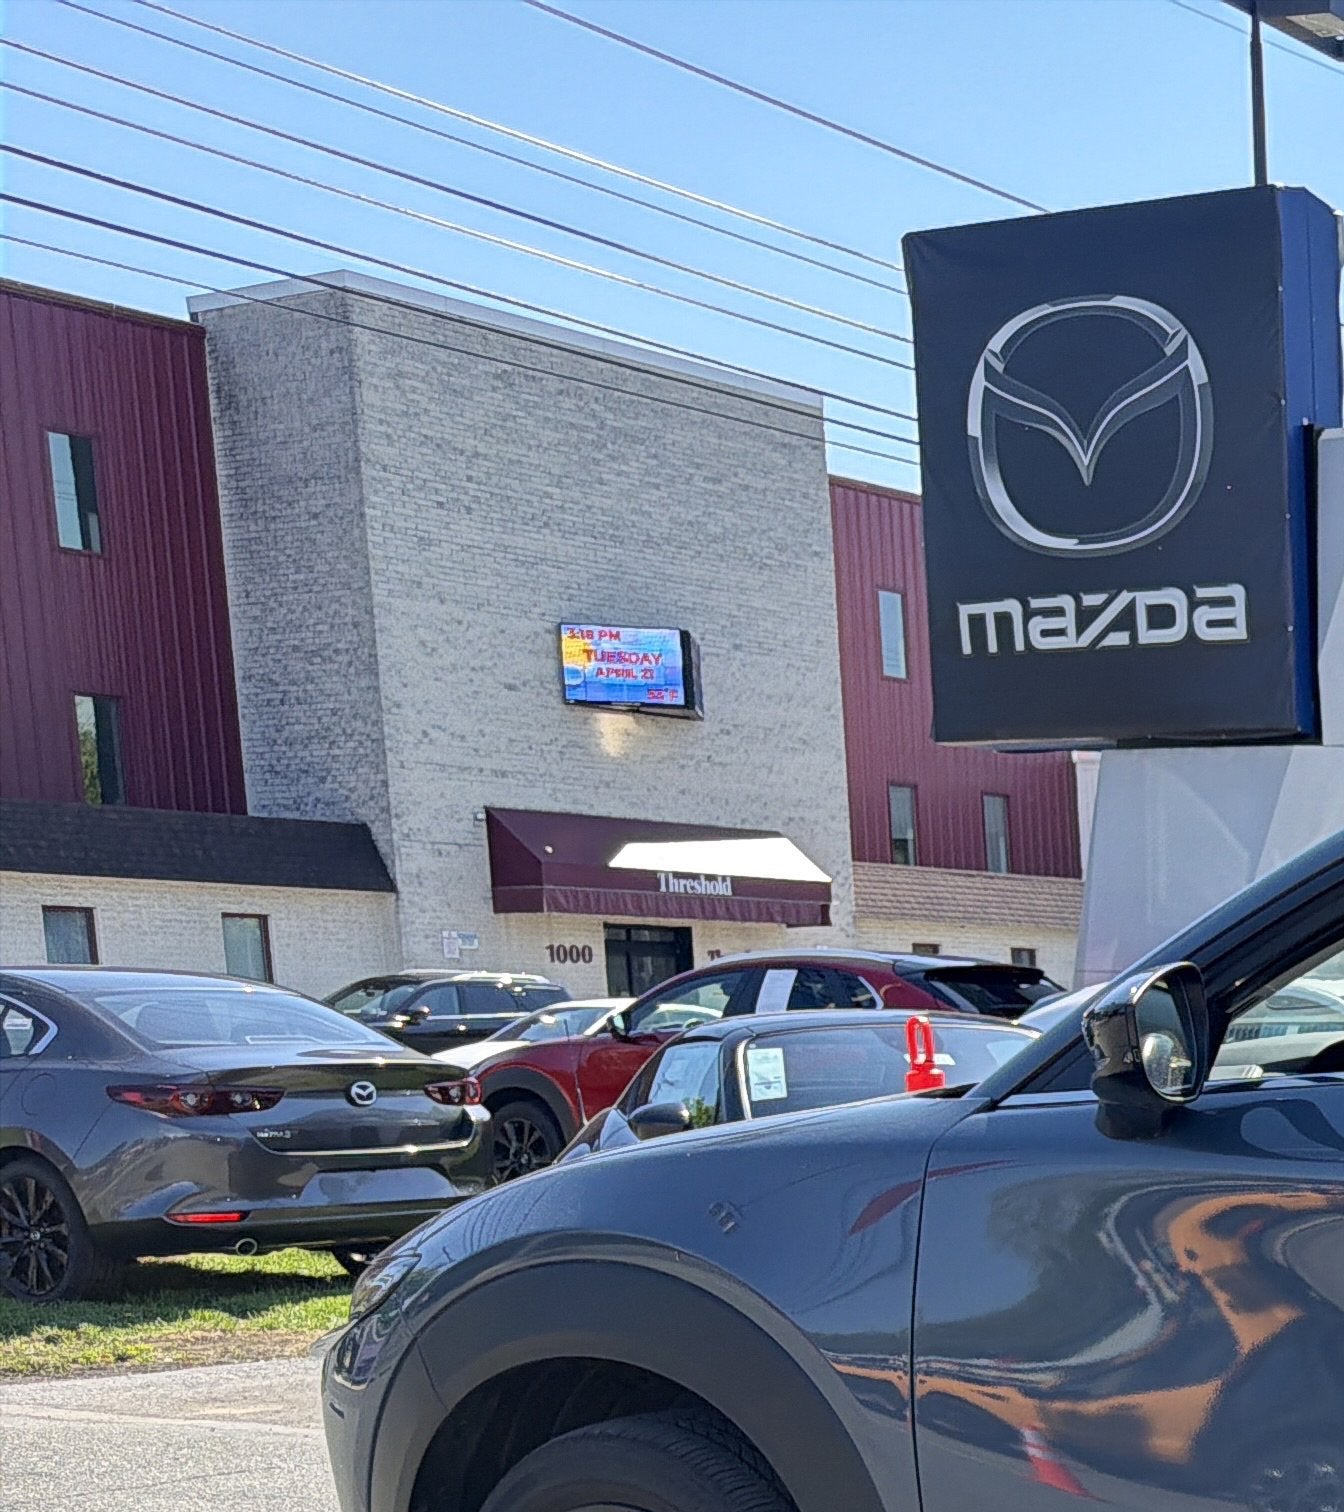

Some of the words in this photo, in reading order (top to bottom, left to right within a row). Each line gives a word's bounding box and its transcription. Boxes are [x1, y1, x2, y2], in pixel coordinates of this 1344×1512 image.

[957, 583, 1248, 655] mazda
[598, 629, 621, 641] PM
[582, 648, 663, 666] TUESDAY
[595, 666, 638, 680] APRIL
[657, 872, 733, 896] Threshold
[545, 944, 593, 964] 1000
